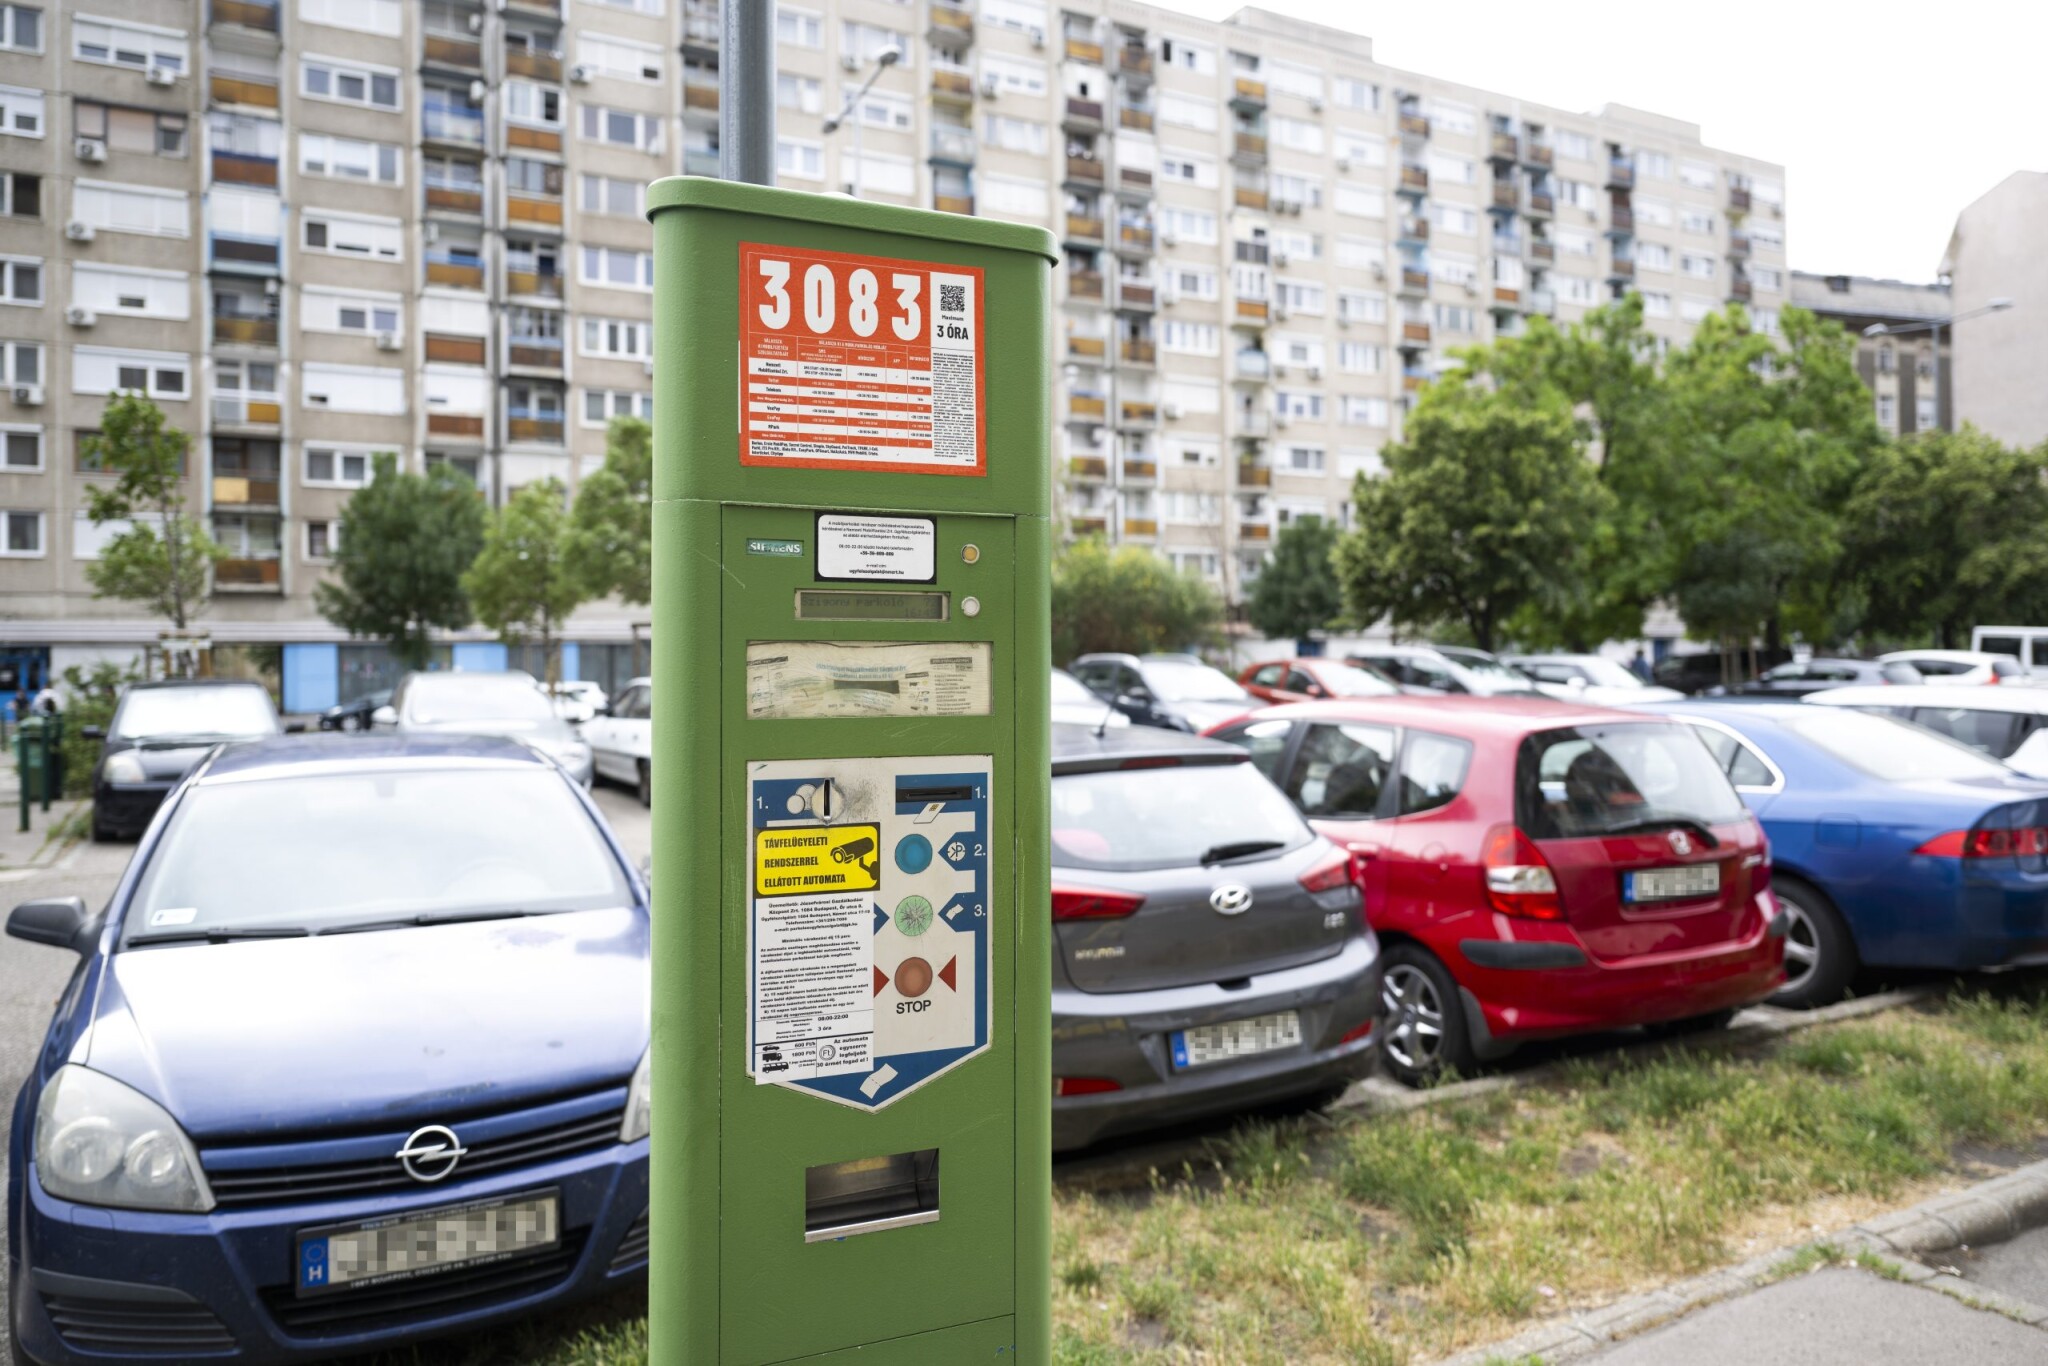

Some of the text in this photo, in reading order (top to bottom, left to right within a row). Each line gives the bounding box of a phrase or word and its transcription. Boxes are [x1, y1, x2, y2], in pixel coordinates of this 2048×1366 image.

[759, 259, 922, 341] 3083
[937, 323, 968, 340] 3 ÓRA
[975, 786, 986, 799] 1.
[756, 796, 769, 809] 1.
[764, 836, 828, 848] TÁVFELÜGYELETI
[974, 844, 986, 856] 2.
[764, 856, 819, 868] RENDSZERREL
[764, 874, 846, 888] ELLÁTOTT AUTOMATA
[974, 904, 986, 917] 3.
[896, 999, 932, 1015] STOP
[308, 1265, 323, 1282] H
